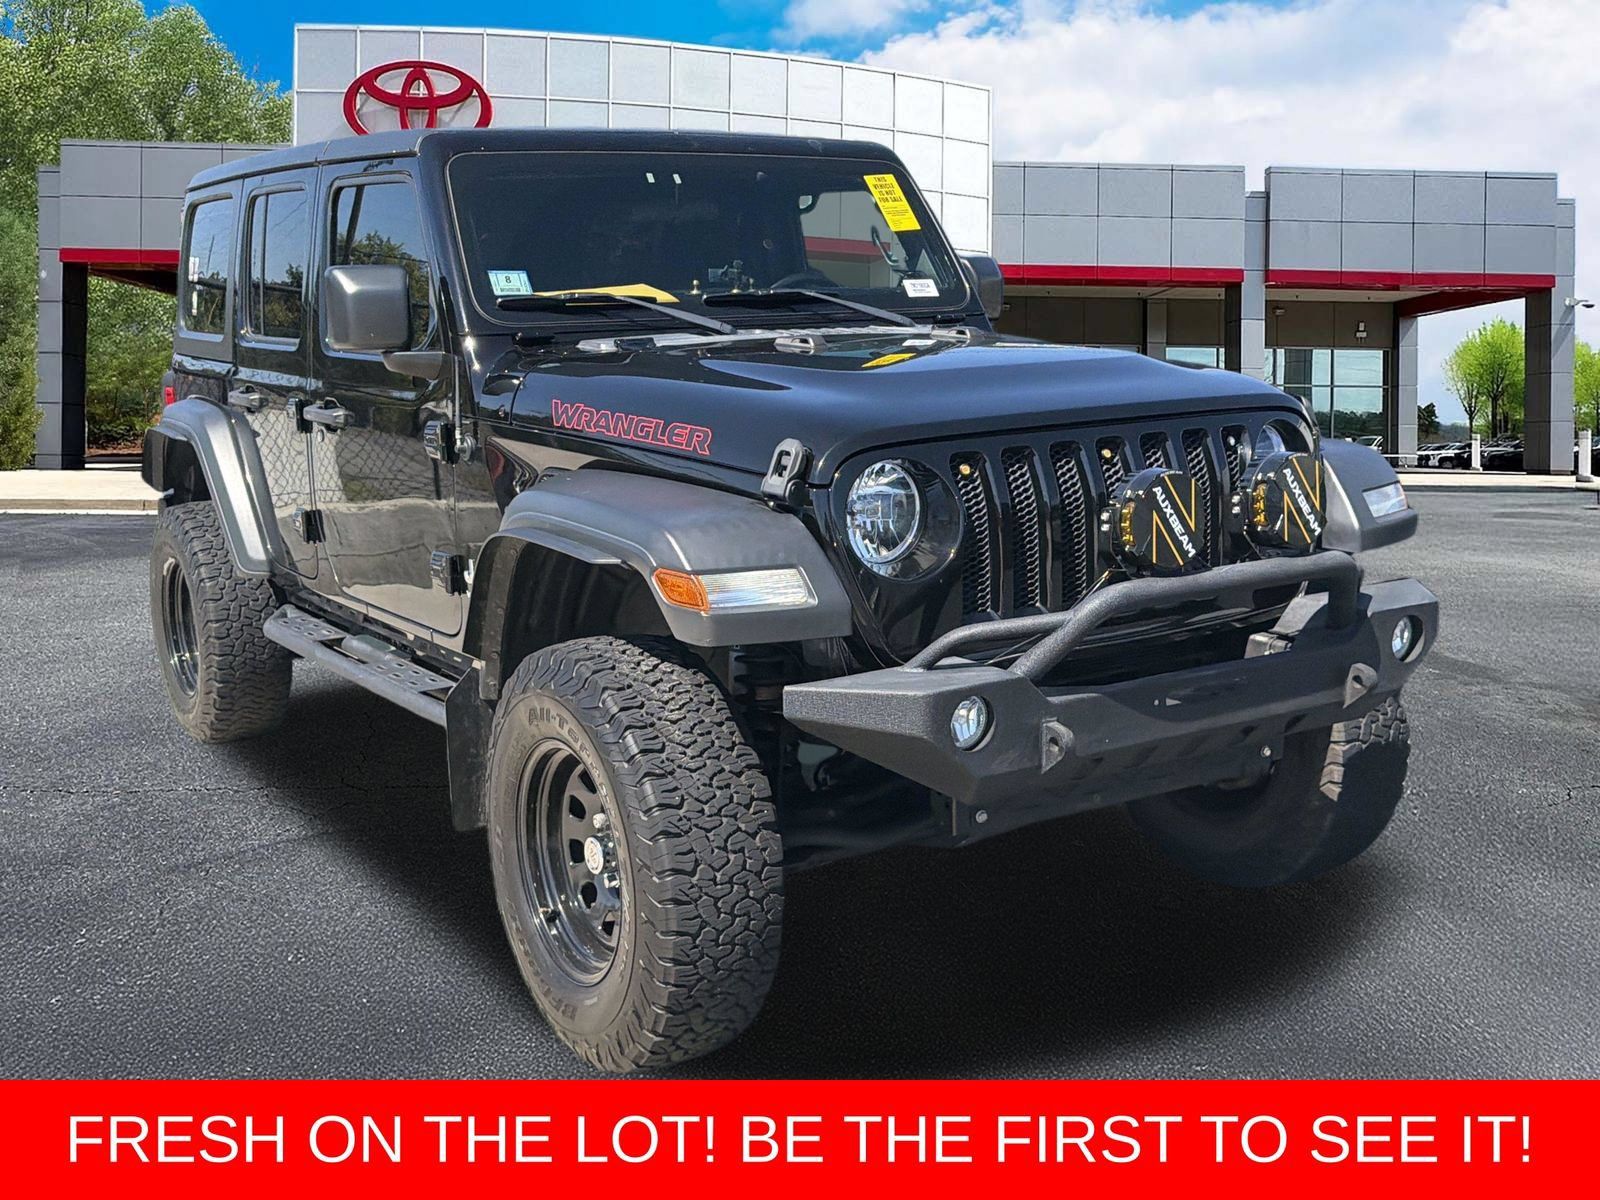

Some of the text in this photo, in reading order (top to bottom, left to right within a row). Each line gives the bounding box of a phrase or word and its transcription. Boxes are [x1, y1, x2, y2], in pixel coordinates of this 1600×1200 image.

[504, 275, 512, 284] 8
[552, 399, 712, 456] WRANGLER
[1152, 486, 1196, 558] AUXBEAM
[1283, 467, 1322, 536] AUXBEAM
